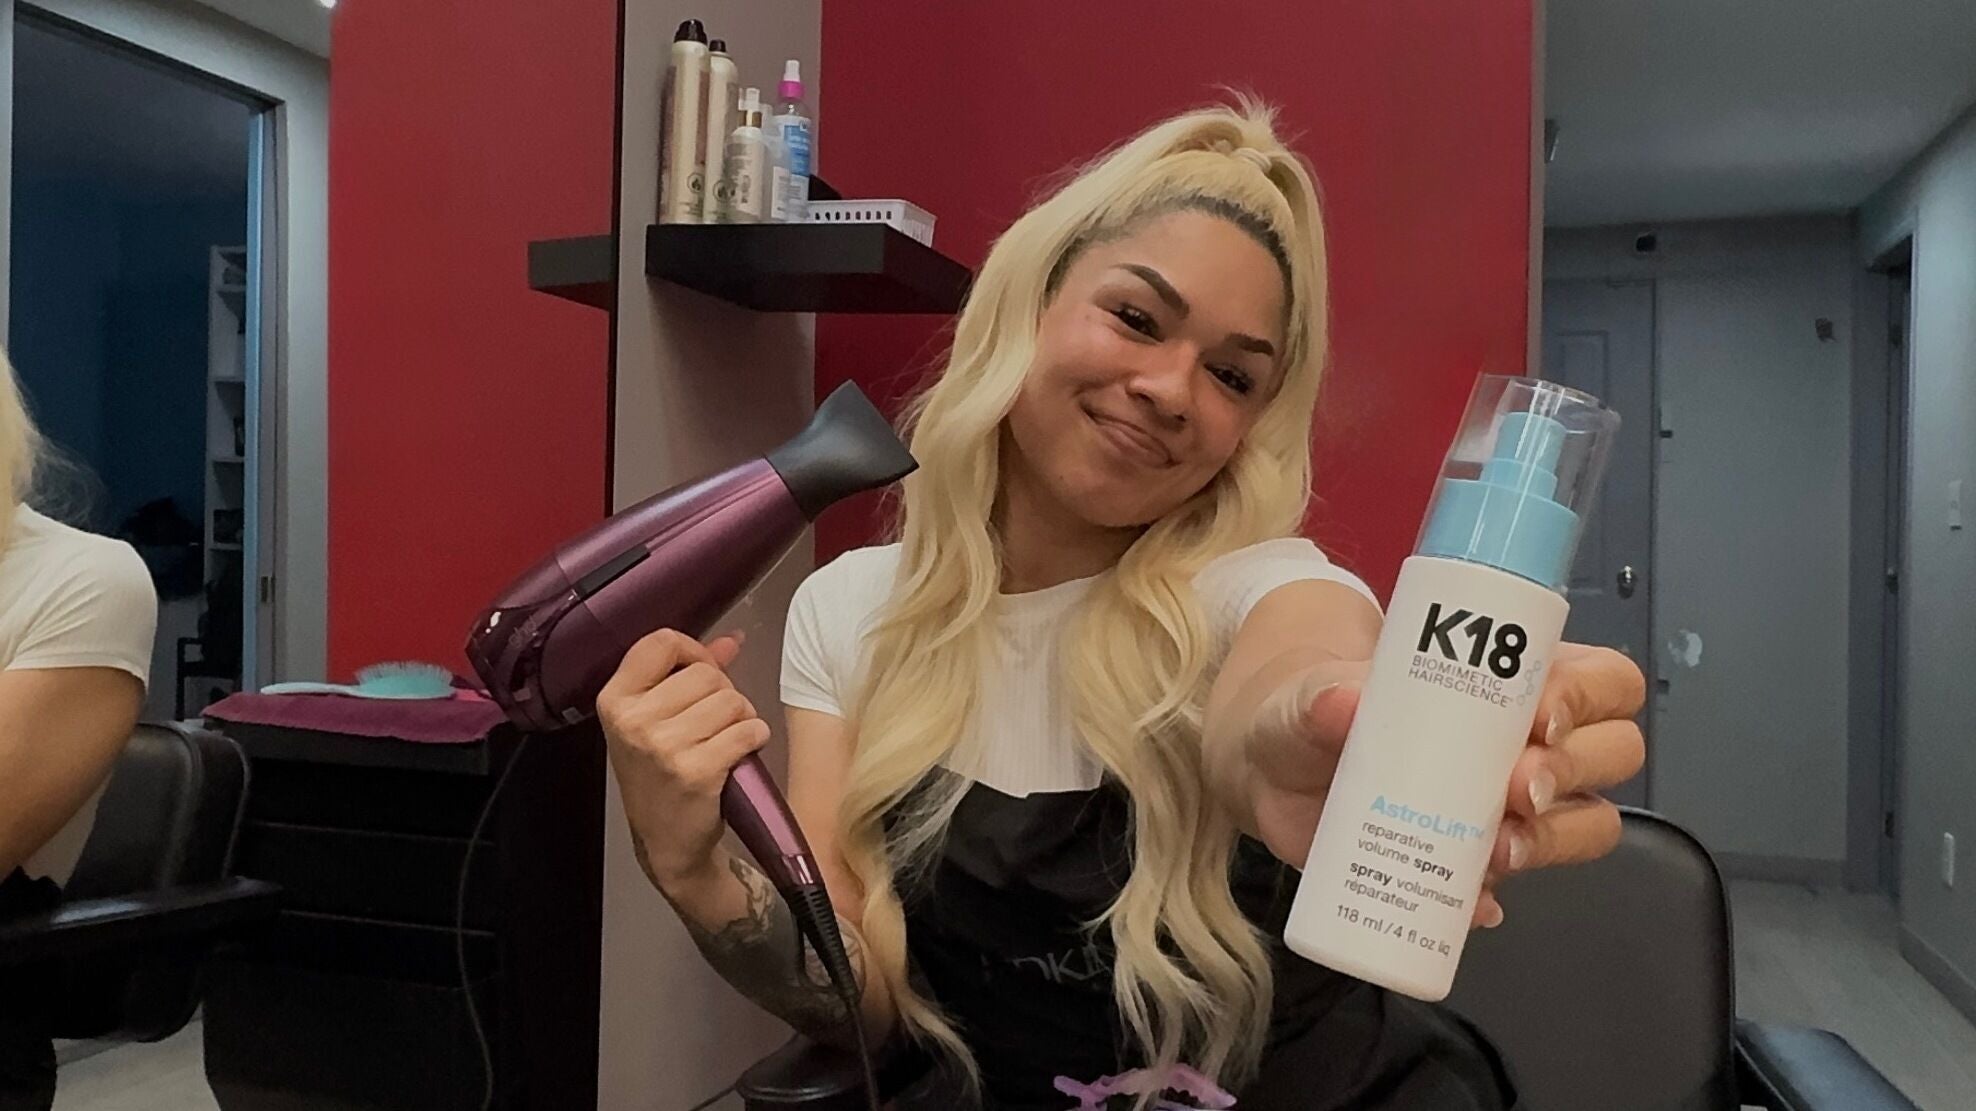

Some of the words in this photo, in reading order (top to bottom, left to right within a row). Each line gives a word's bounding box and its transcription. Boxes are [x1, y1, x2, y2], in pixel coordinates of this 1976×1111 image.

[1416, 602, 1527, 679] K18
[1411, 654, 1503, 692] BIOMIMETIC
[1361, 821, 1434, 853] reparative
[1349, 861, 1393, 886] spray
[1358, 838, 1410, 864] volume
[1413, 857, 1454, 881] spray
[1344, 878, 1420, 912] réparateur
[1336, 904, 1359, 923] 118
[1362, 915, 1384, 932] ml
[1407, 930, 1418, 944] fl
[1419, 936, 1436, 950] oz
